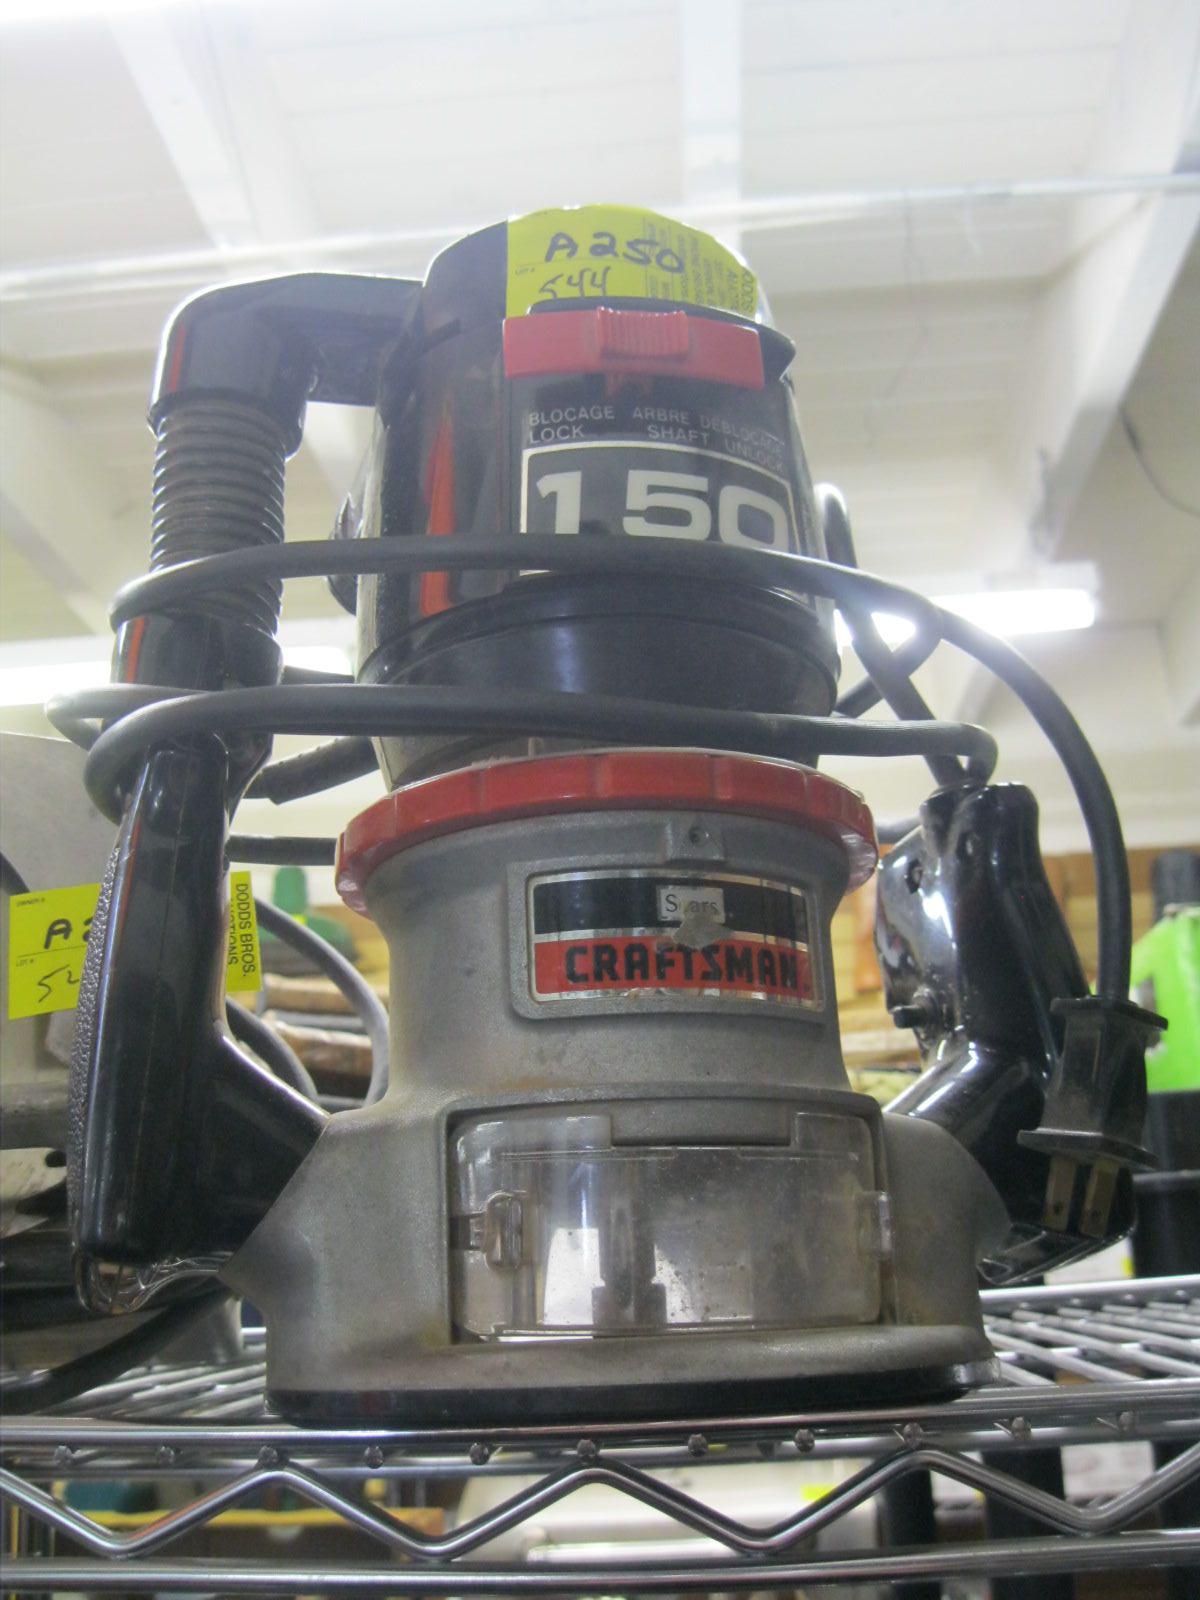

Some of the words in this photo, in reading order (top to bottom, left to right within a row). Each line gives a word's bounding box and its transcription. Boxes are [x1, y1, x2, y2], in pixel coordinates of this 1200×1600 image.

[528, 405, 616, 428] BLOCAGE
[632, 405, 690, 427] ARBRE
[529, 424, 585, 444] LOCK
[648, 424, 710, 446] SHAFT
[536, 469, 789, 551] 150
[235, 883, 252, 930] DODDS
[665, 894, 721, 914] Sars
[240, 933, 256, 977] BROS.
[564, 942, 799, 992] CRAFTSMAN
